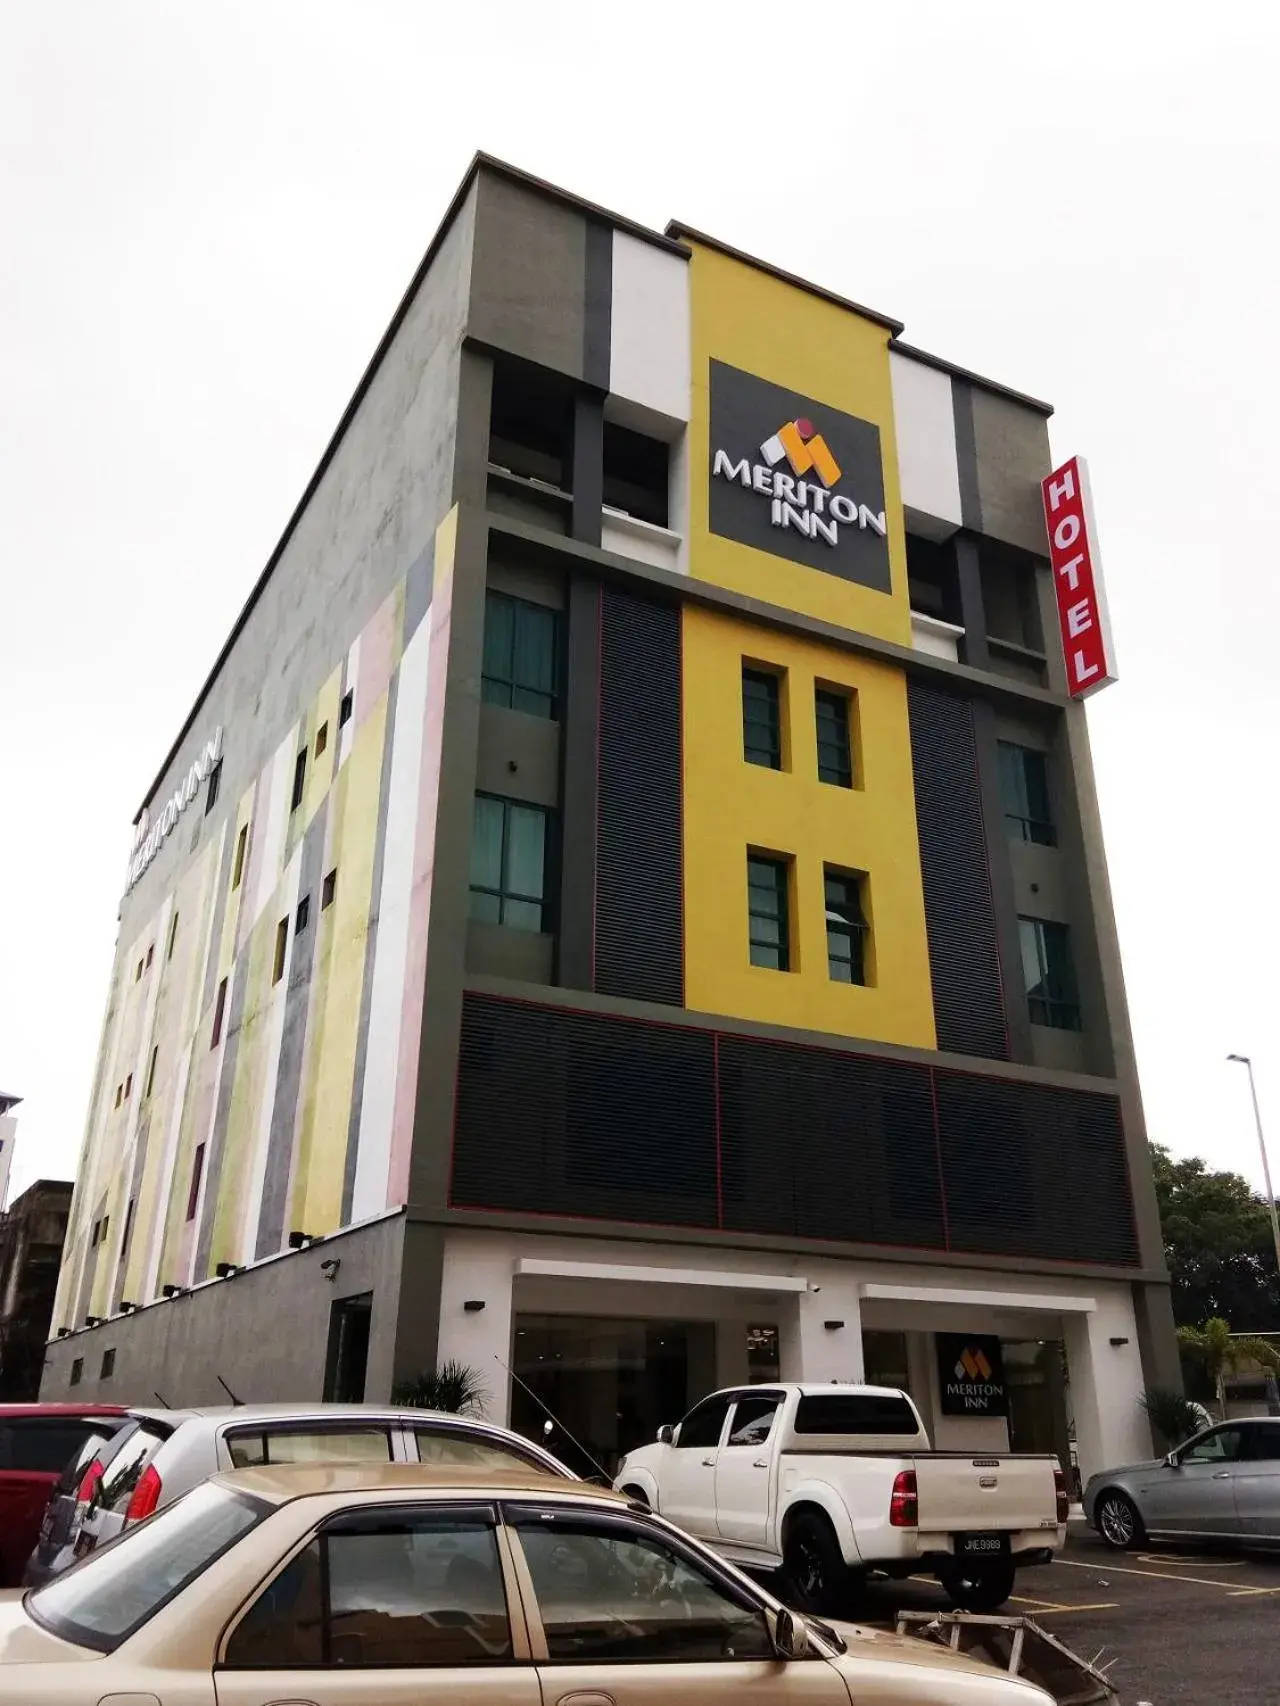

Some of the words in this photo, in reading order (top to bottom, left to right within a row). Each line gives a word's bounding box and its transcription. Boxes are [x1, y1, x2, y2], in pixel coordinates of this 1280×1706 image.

[713, 449, 887, 537] MERITON
[771, 498, 838, 548] INN
[1048, 469, 1099, 683] HOTEL
[947, 1383, 1003, 1396] MERITON
[964, 1396, 988, 1409] INN
